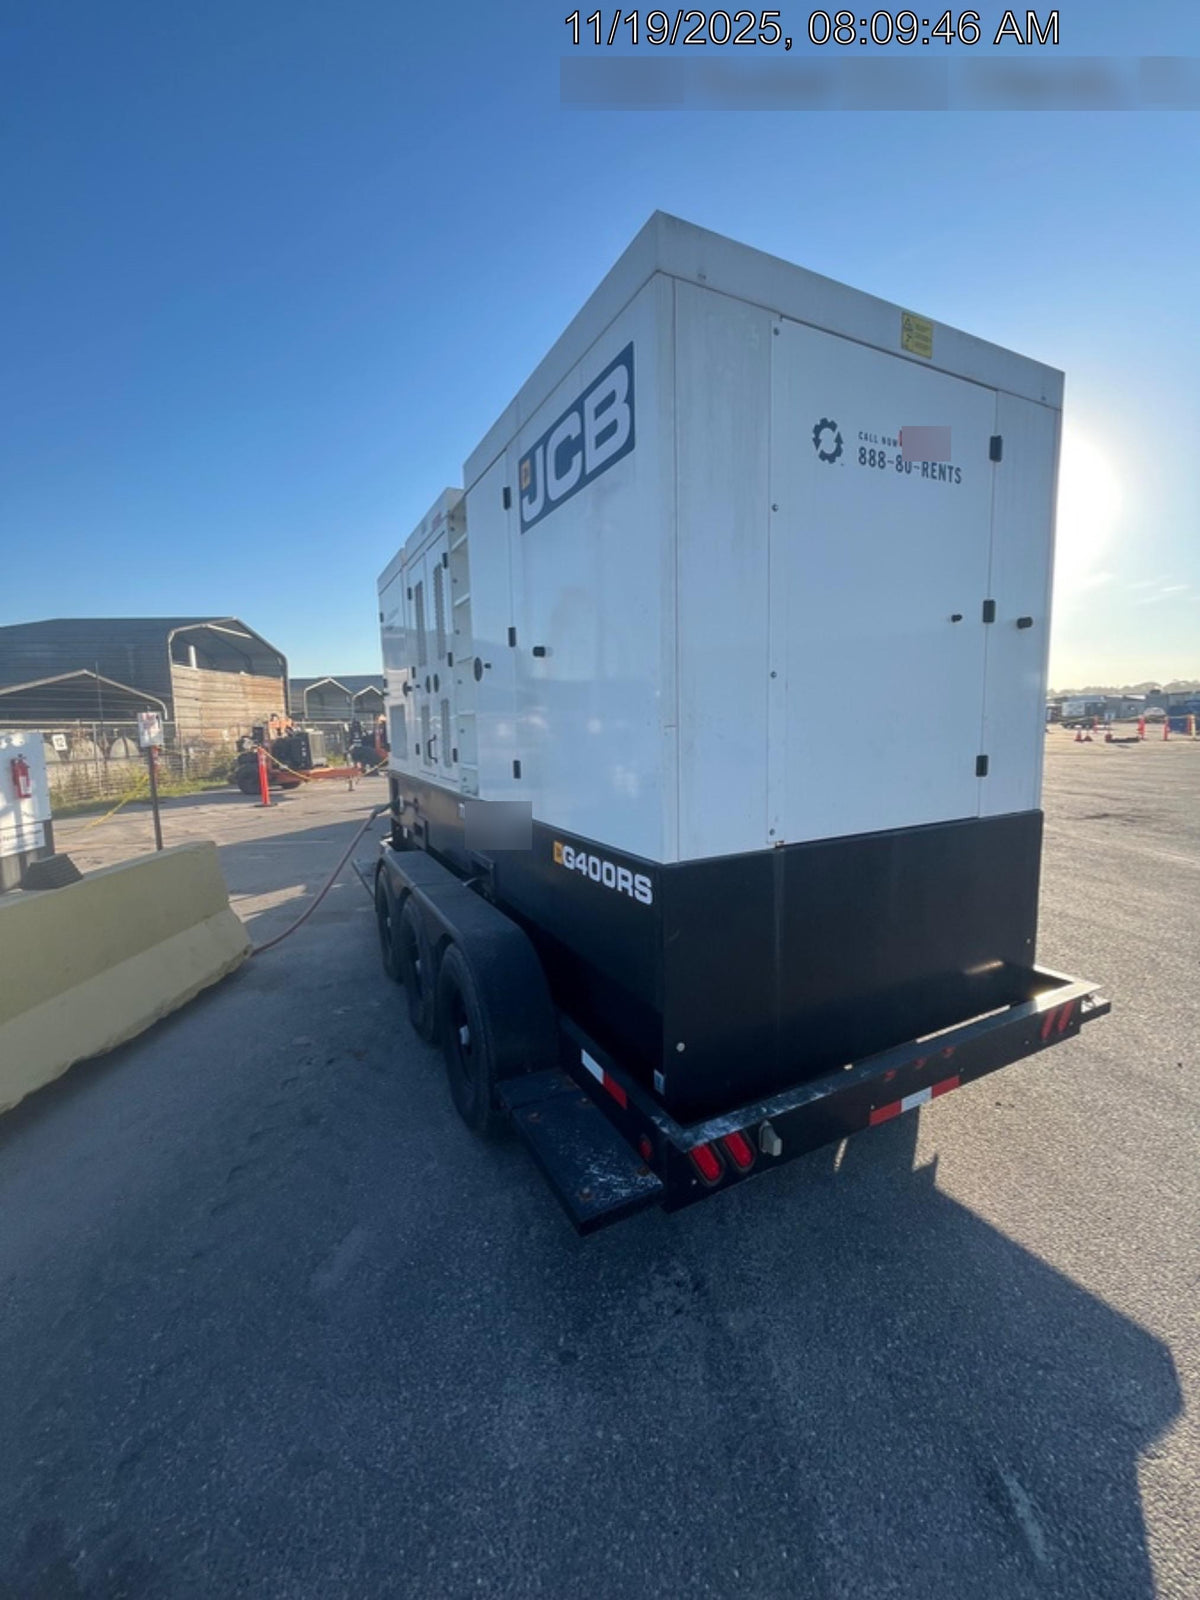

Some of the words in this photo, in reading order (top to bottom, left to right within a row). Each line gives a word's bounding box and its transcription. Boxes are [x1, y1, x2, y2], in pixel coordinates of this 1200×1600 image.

[522, 364, 631, 523] JCB
[858, 431, 878, 444] CALL
[882, 436, 898, 448] NOW
[858, 446, 962, 485] 888-80-RENTS
[562, 845, 653, 905] G400RS
